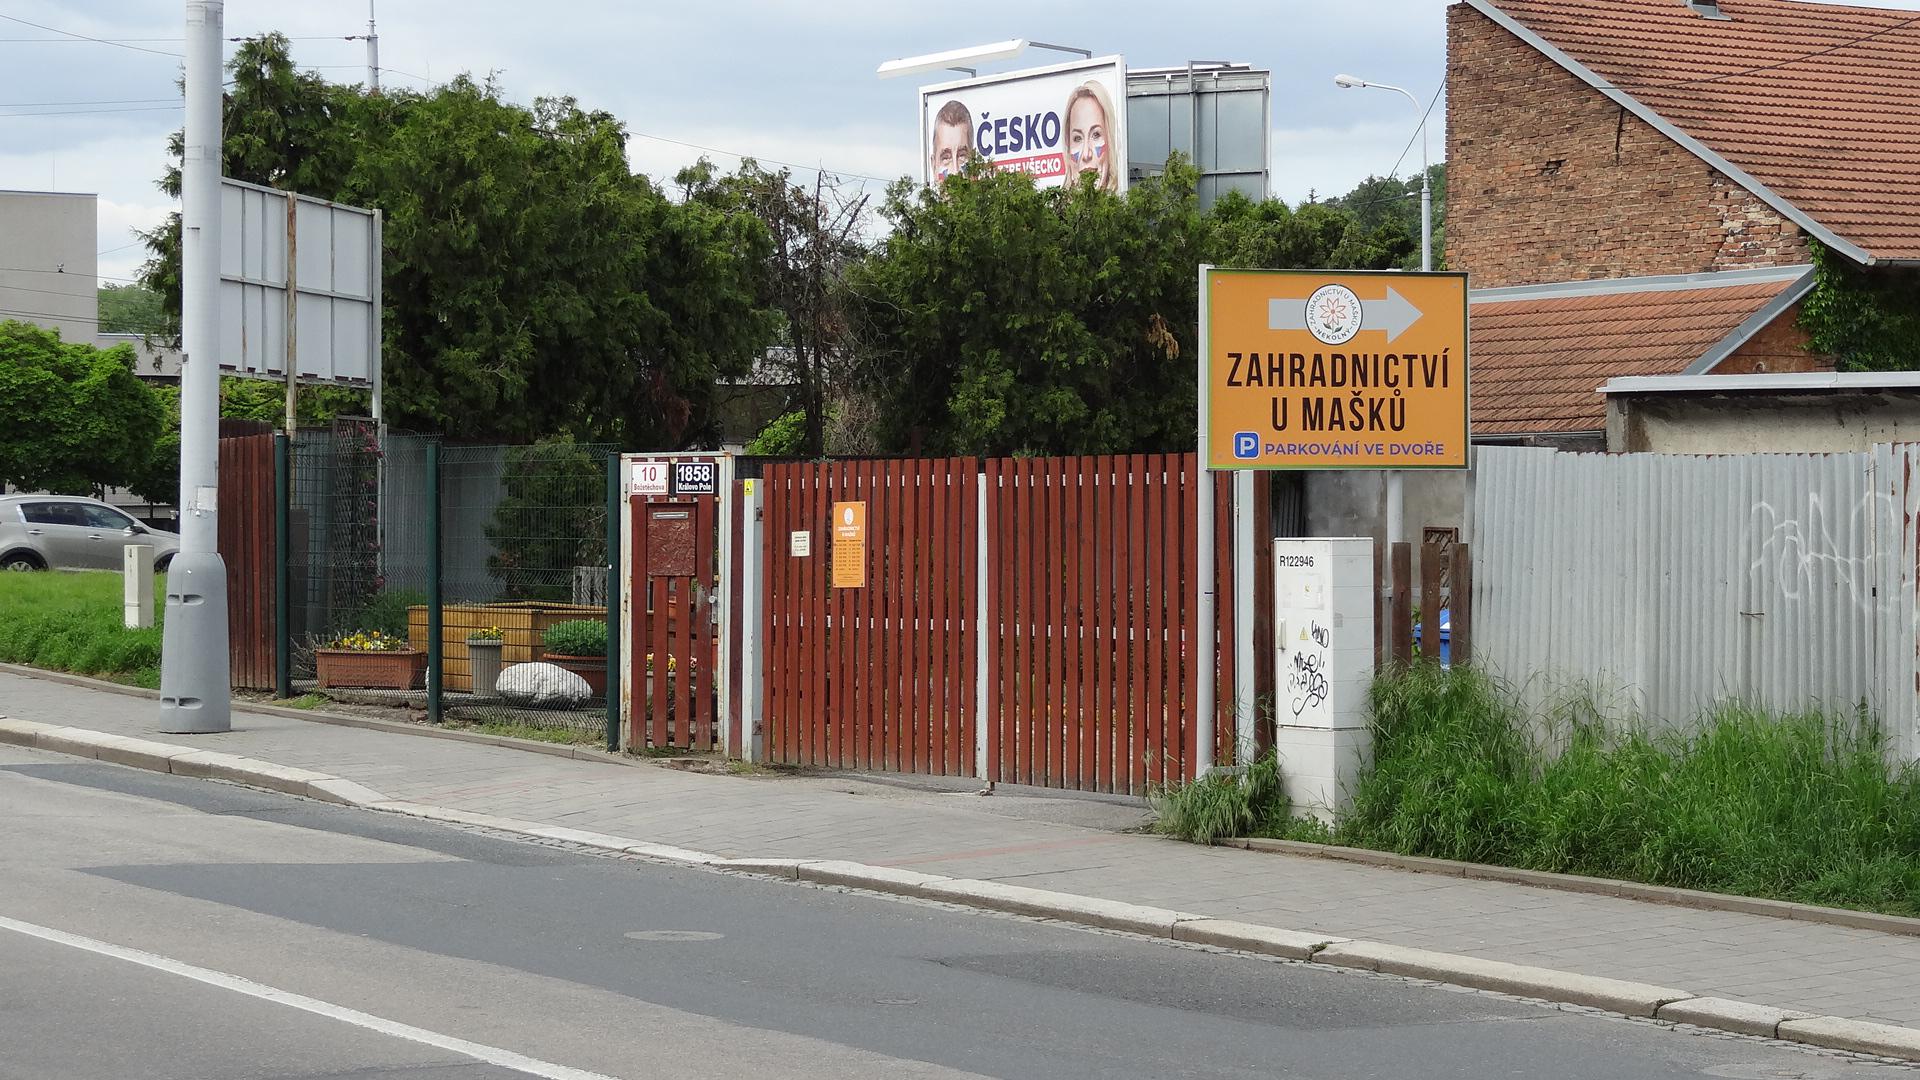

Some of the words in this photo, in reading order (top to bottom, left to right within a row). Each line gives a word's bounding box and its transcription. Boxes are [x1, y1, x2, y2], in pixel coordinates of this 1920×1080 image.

[976, 111, 1061, 157] ČESKO
[1022, 157, 1061, 175] VŠECKO
[1227, 347, 1450, 388] ZAHRADNICTVÍ
[1272, 397, 1288, 431] U
[1302, 388, 1405, 431] MAŠKŮ
[1240, 437, 1256, 454] P
[1265, 440, 1359, 455] PARKOVÁNÍ
[1364, 444, 1384, 455] VE
[1389, 441, 1444, 455] DVOŘE
[642, 466, 657, 482] 10
[678, 466, 710, 482] 1858
[678, 482, 698, 491] Královo
[699, 482, 711, 491] Pole
[1279, 555, 1314, 568] R122946
